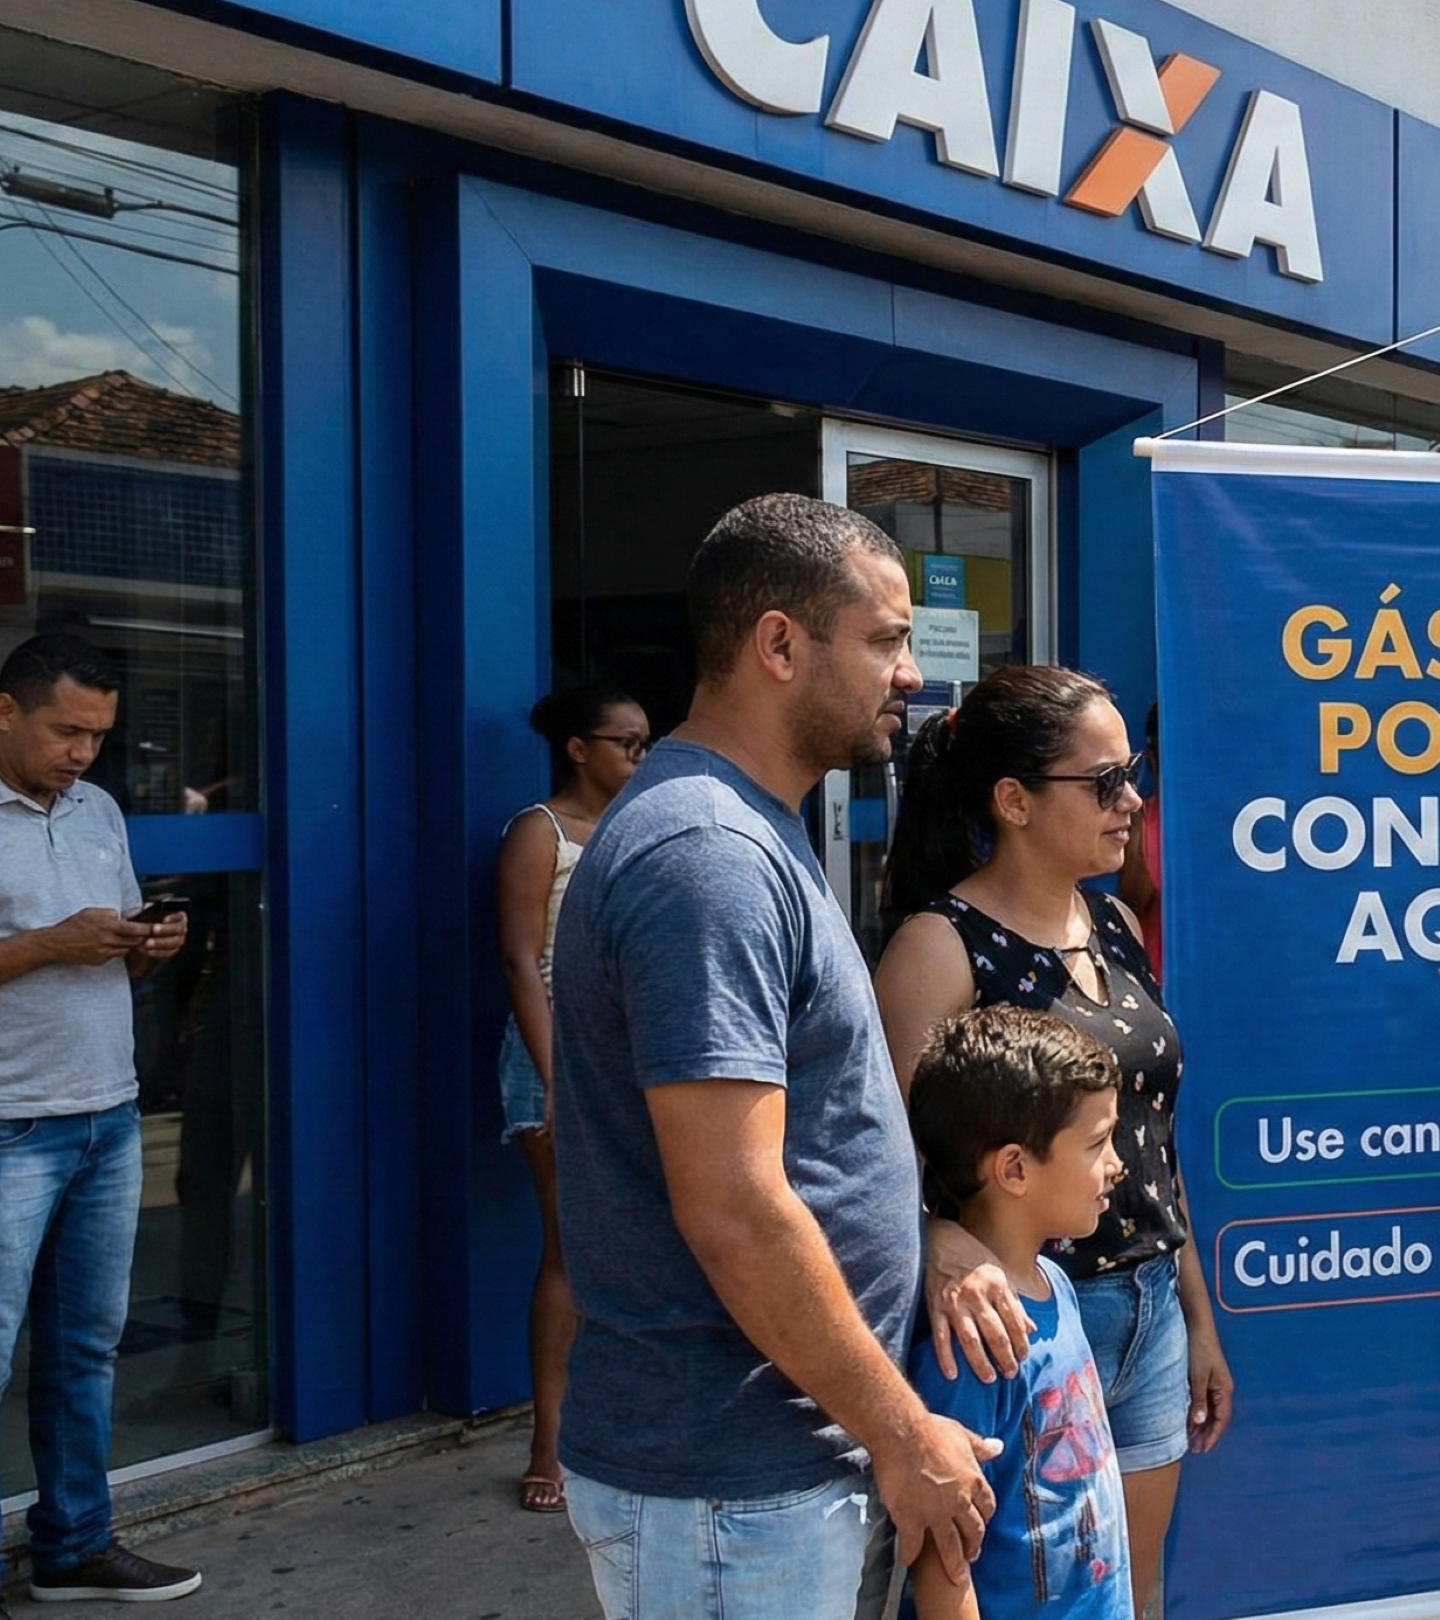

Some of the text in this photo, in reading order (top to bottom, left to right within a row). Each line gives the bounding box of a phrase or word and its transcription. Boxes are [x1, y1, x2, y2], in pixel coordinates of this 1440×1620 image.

[686, 0, 1324, 284] CAIXA
[1258, 1116, 1345, 1164] Use
[1233, 1225, 1433, 1288] Cuidado
